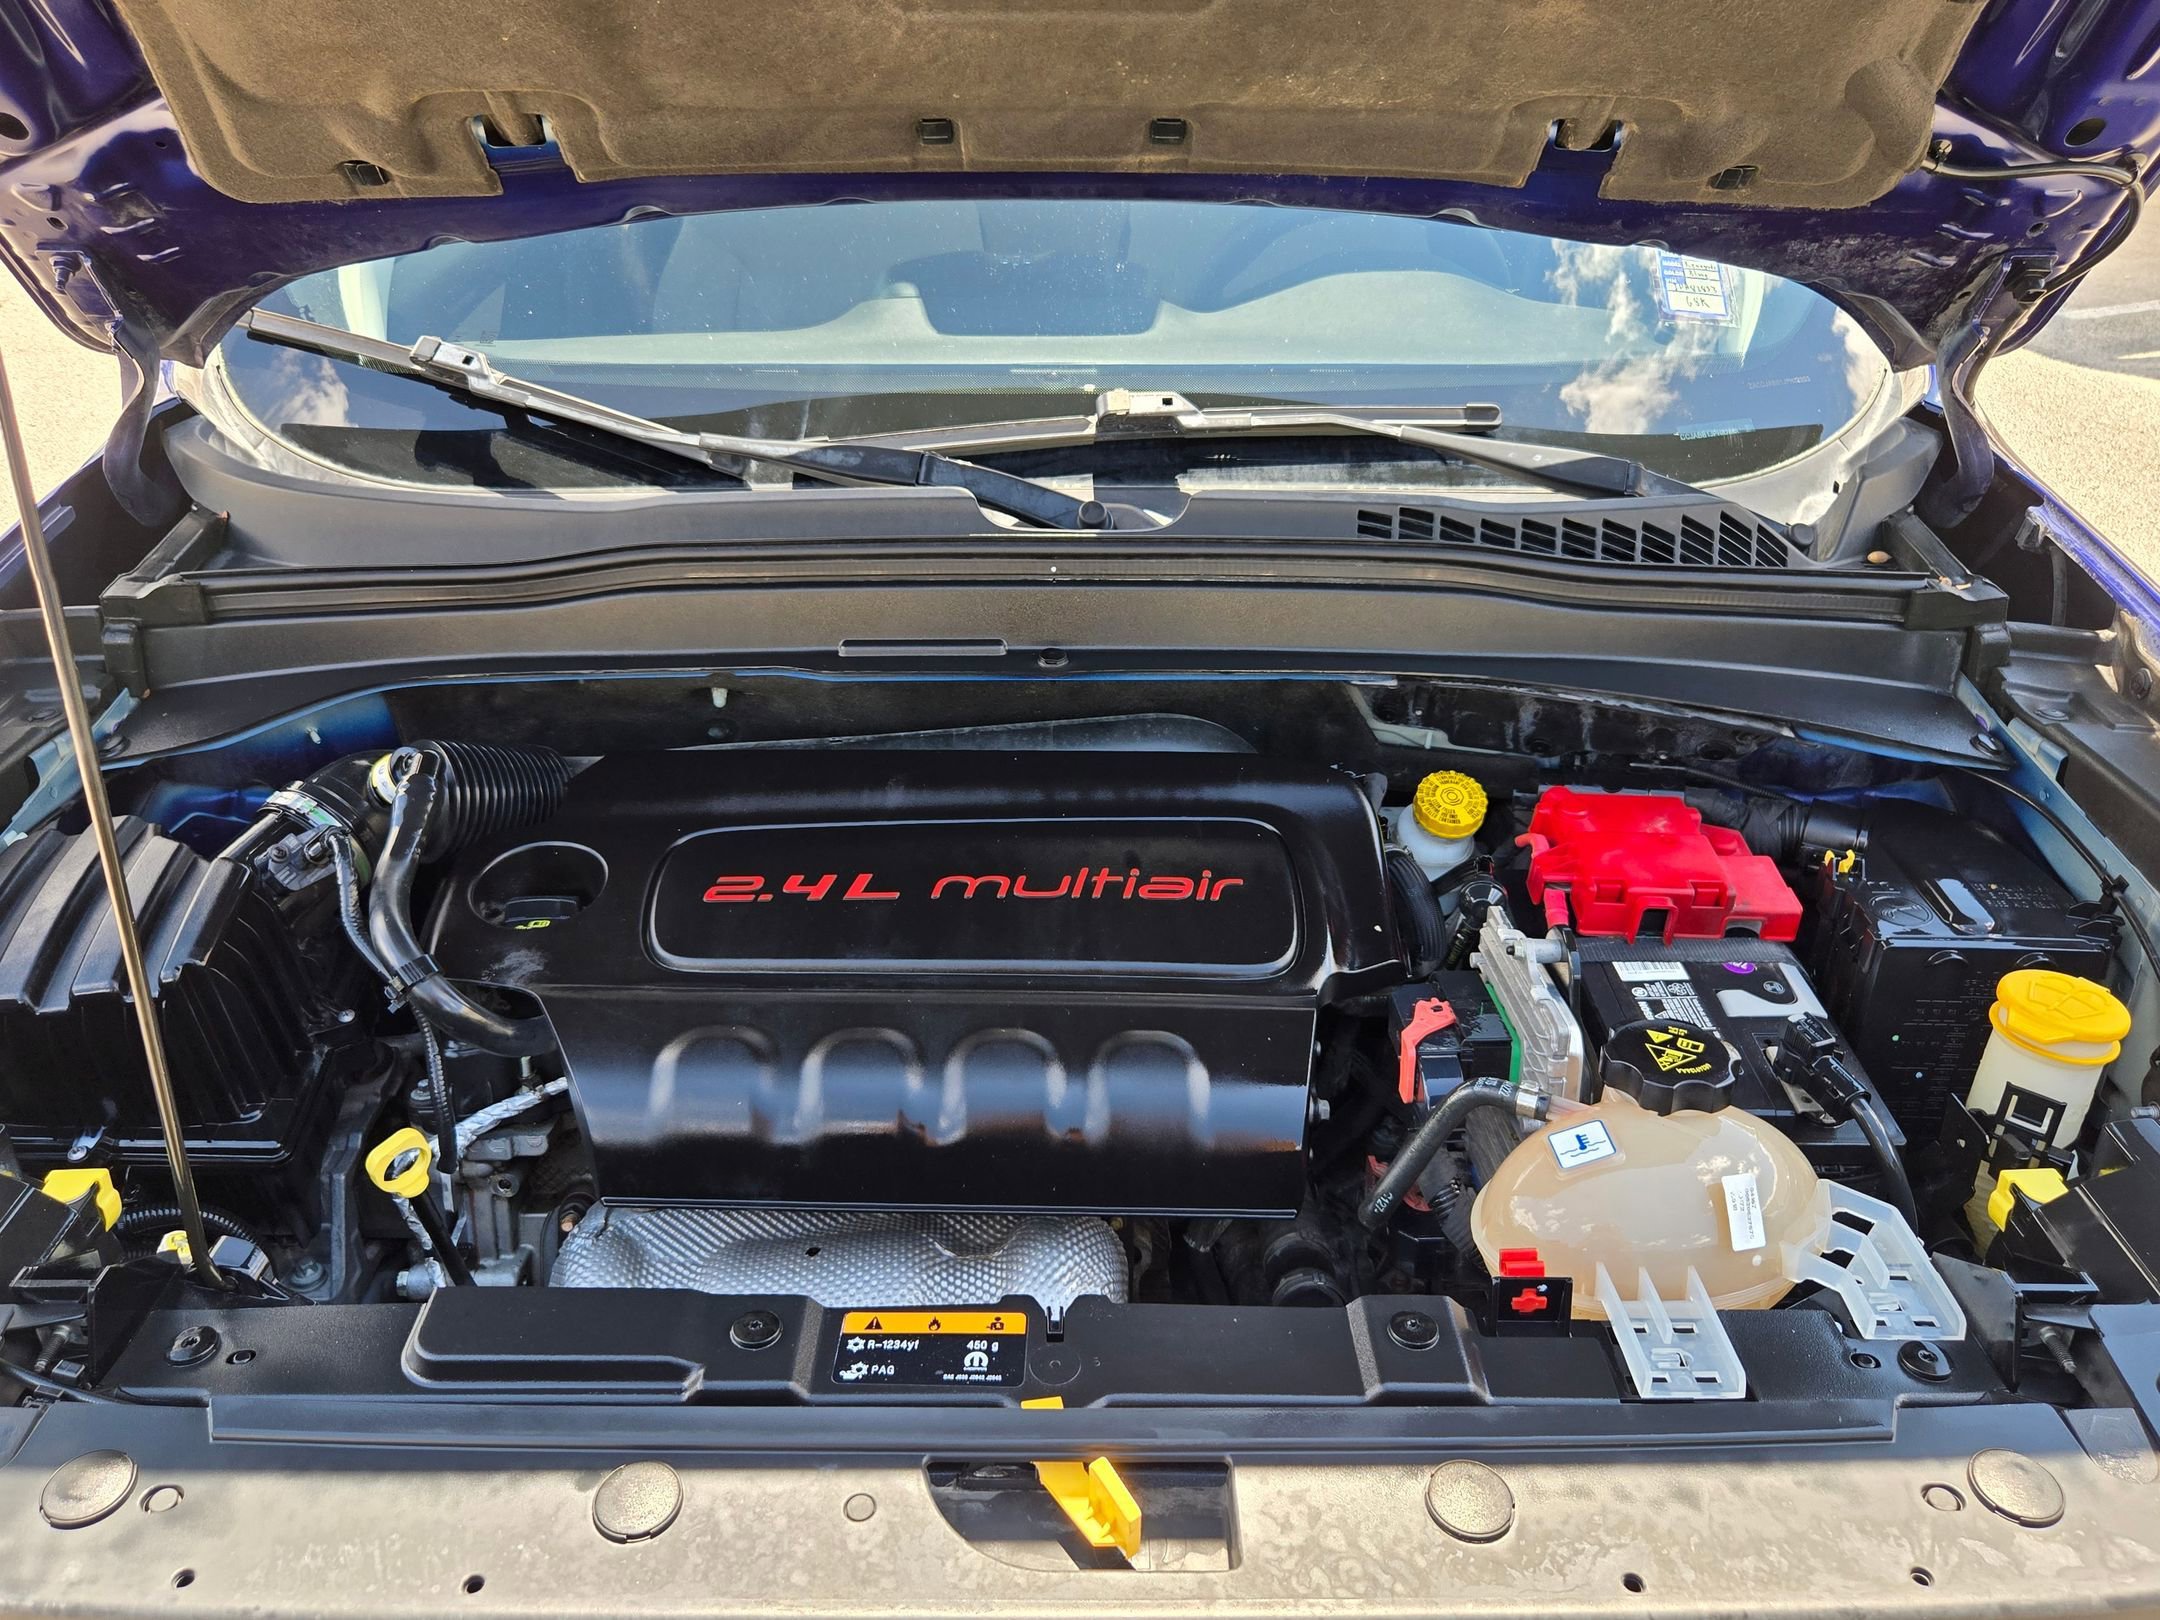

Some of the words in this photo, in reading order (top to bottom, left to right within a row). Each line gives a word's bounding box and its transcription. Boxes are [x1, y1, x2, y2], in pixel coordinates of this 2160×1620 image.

[930, 867, 1245, 902] multiair
[867, 1339, 920, 1352] R-1234yf
[871, 1364, 895, 1375] PAG
